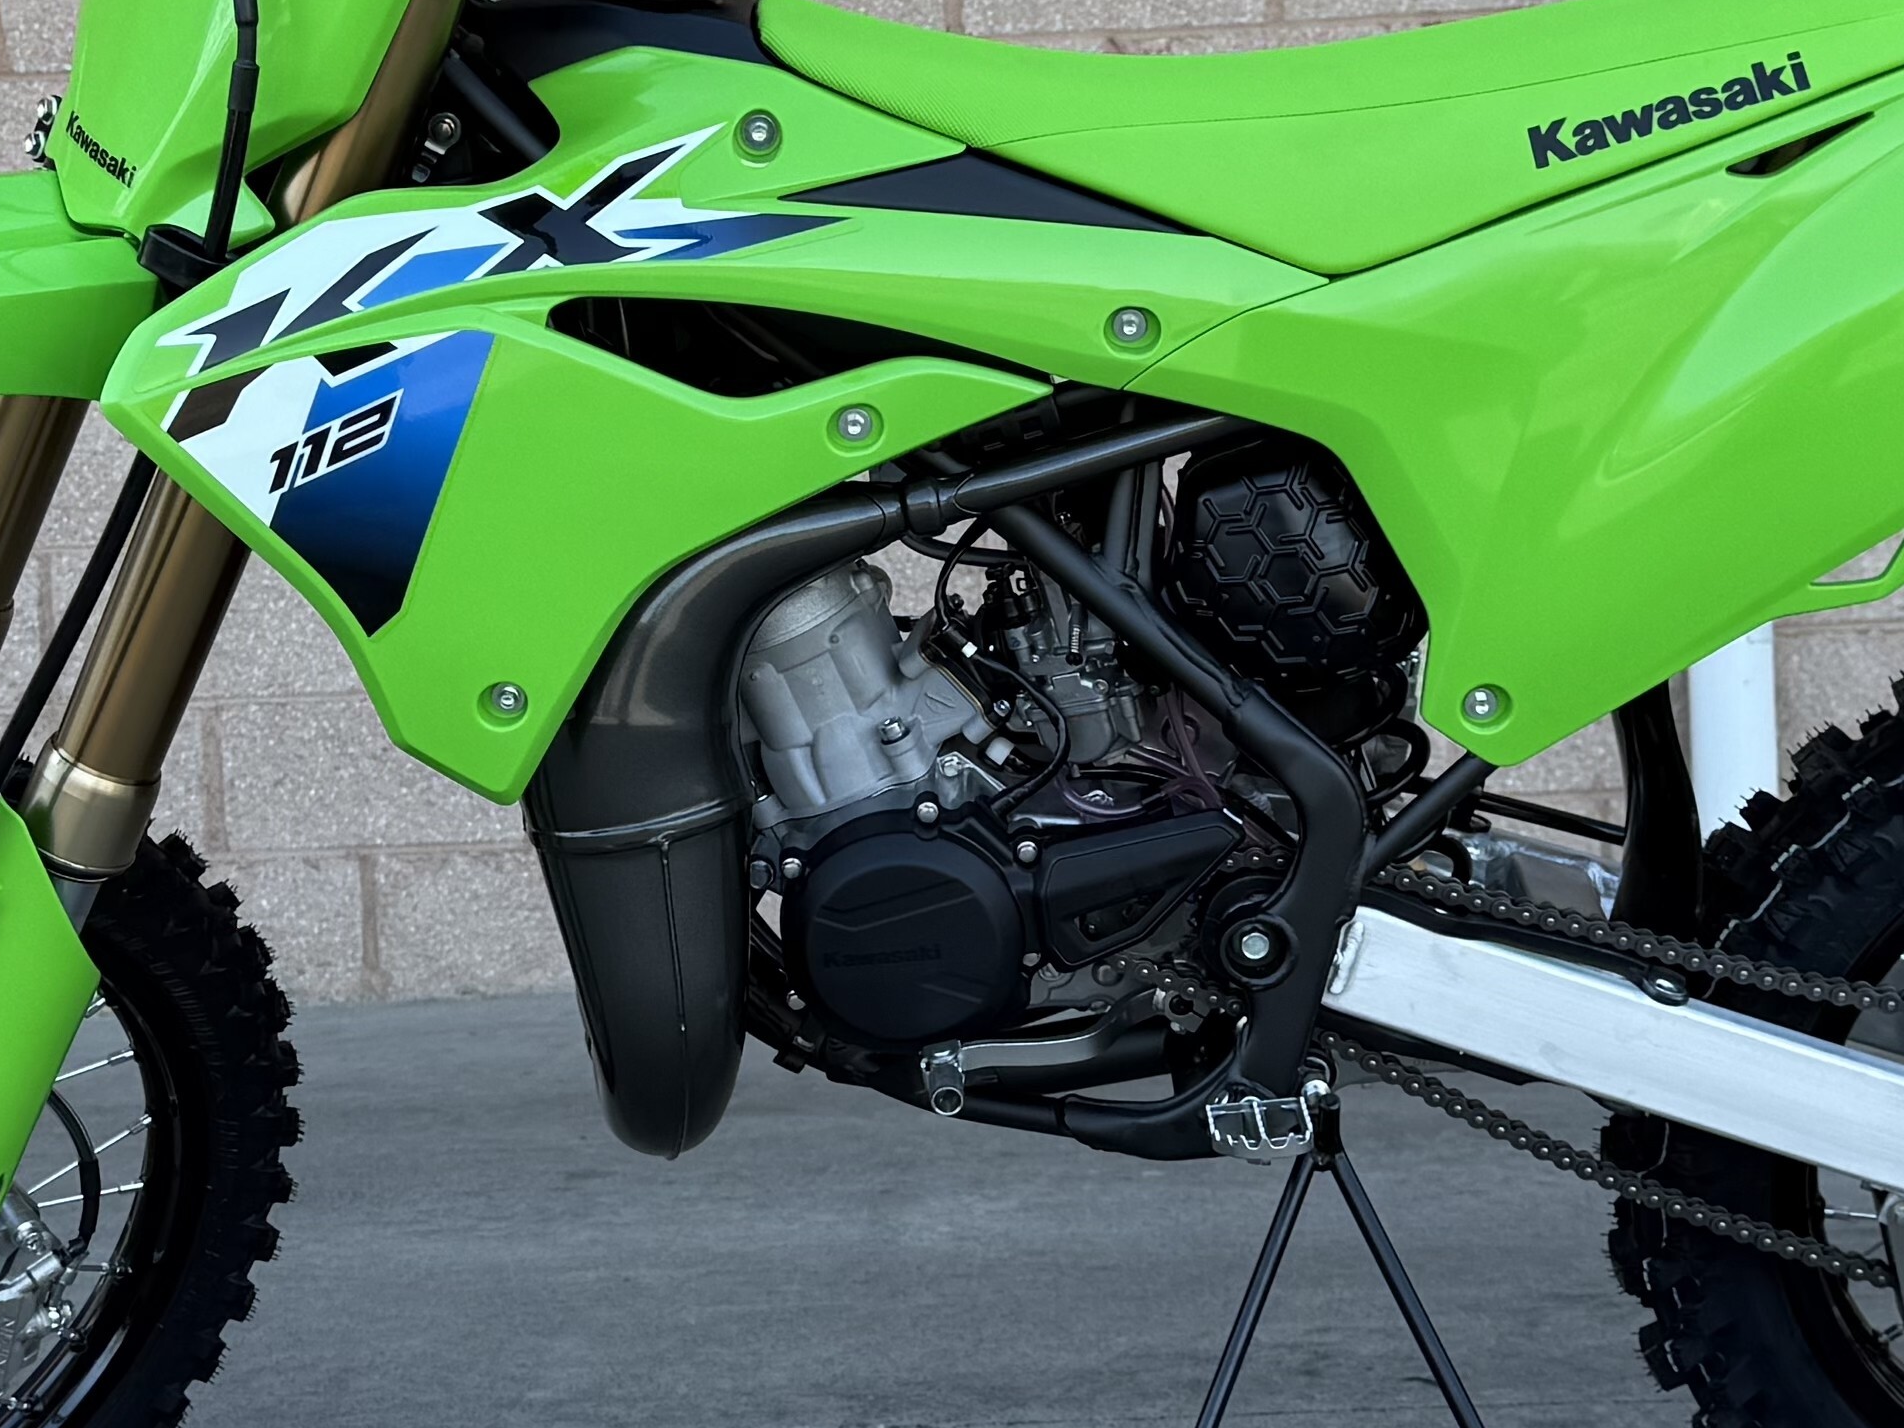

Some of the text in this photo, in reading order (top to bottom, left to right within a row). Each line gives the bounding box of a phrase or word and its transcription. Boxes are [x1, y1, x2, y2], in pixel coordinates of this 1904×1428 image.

[65, 110, 137, 188] Kawasaki
[1527, 50, 1812, 170] Kawasaki
[268, 397, 400, 495] 112
[822, 943, 942, 969] Kawasaki
